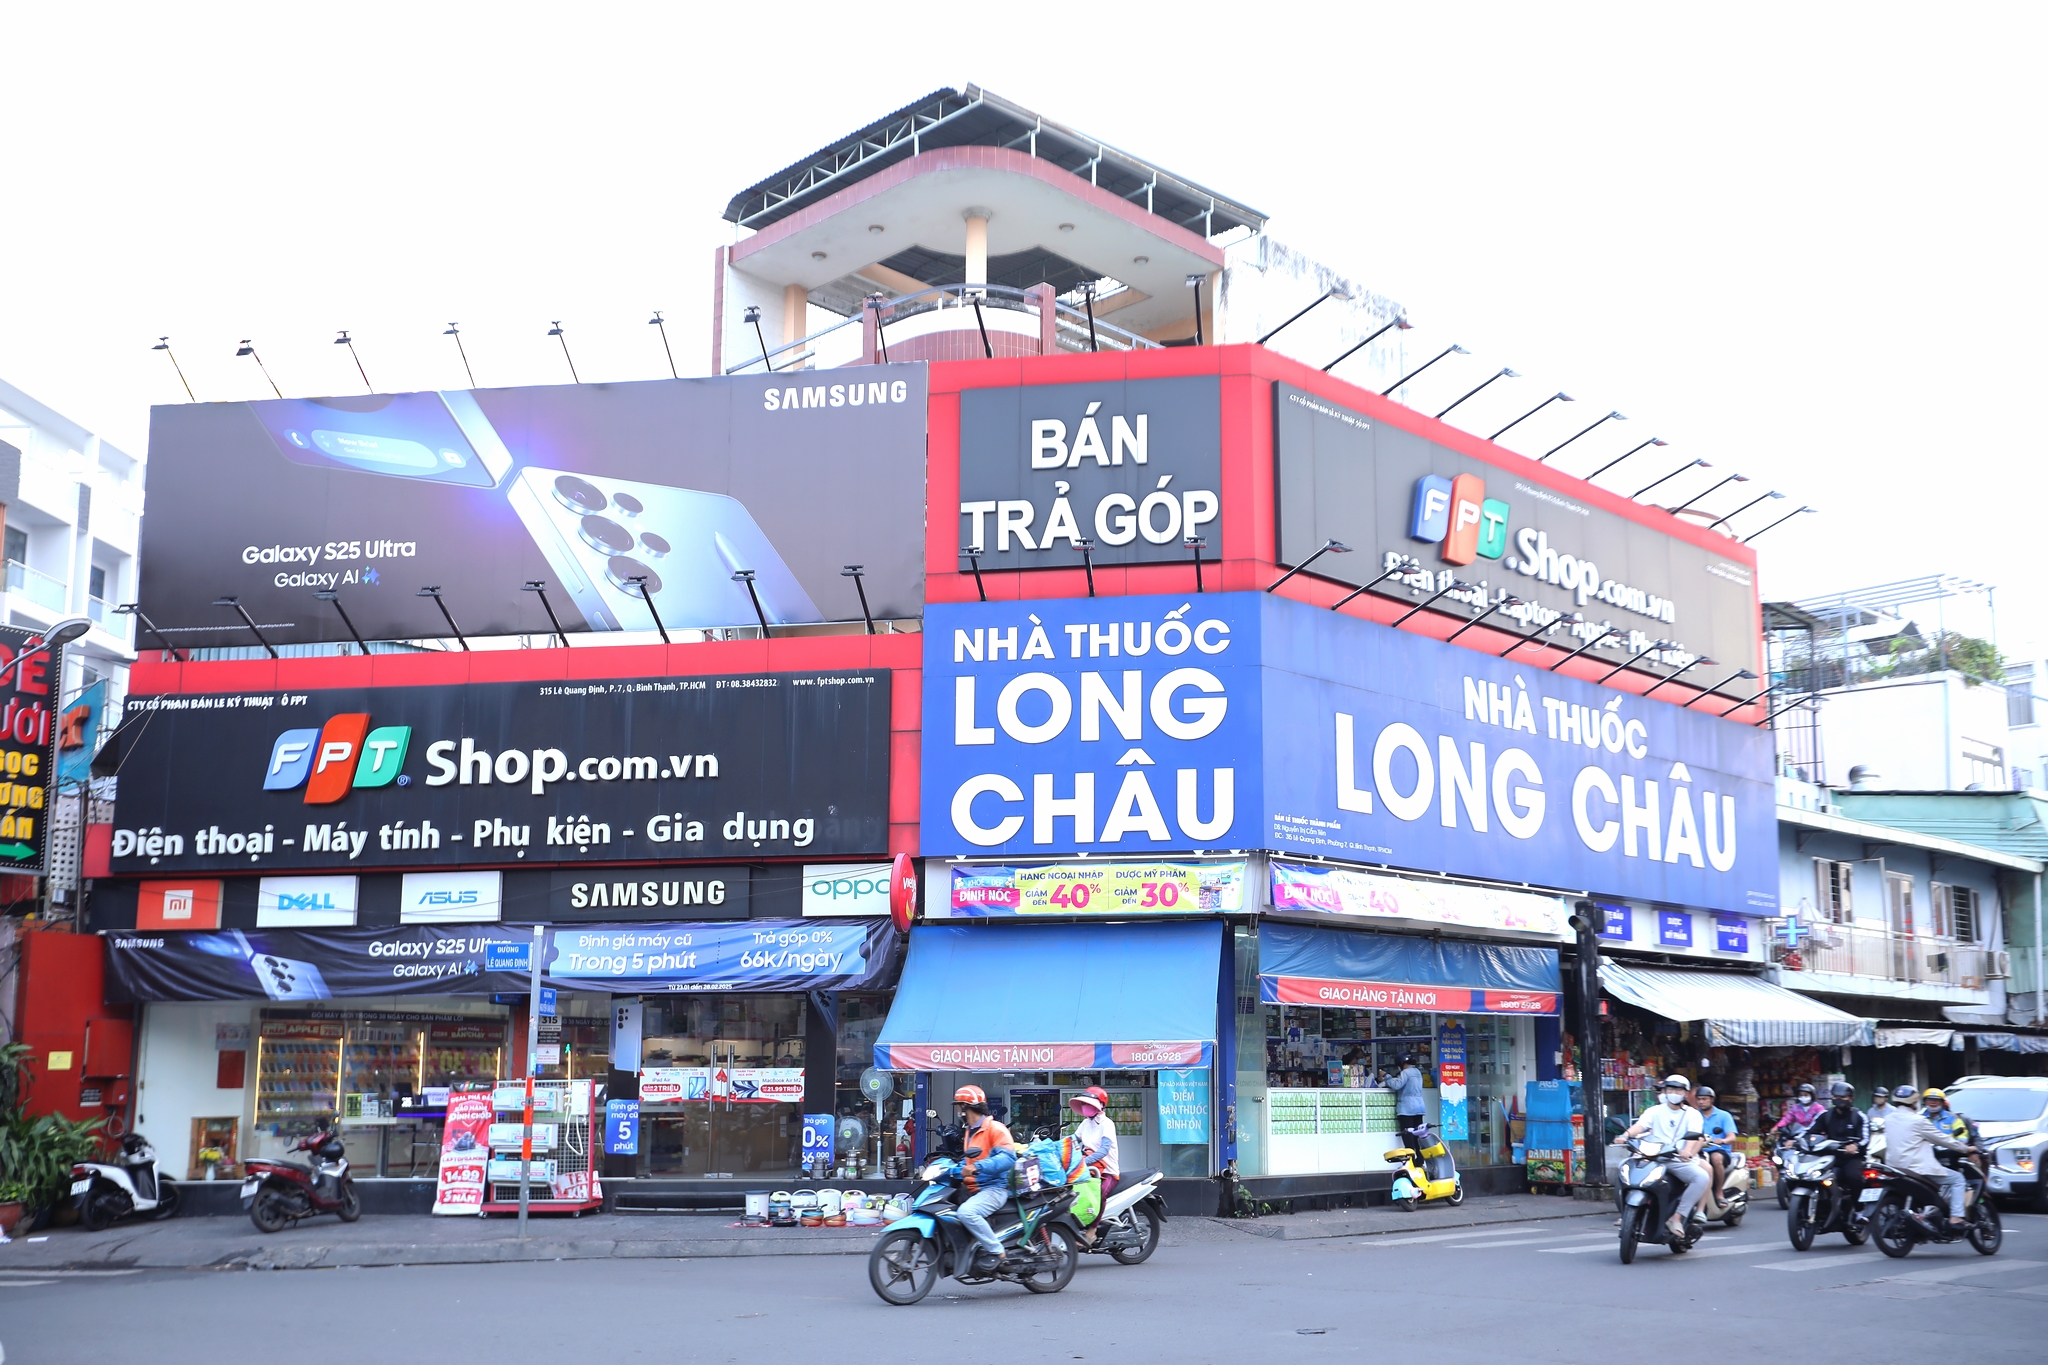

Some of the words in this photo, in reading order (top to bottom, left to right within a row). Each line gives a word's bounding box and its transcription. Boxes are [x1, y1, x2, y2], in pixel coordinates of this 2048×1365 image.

[764, 380, 907, 411] SAMSUNG
[1031, 401, 1148, 469] BÁN
[960, 481, 1081, 552] TRẢ
[1094, 475, 1219, 545] GÓP
[242, 545, 321, 566] Galaxy
[324, 542, 361, 562] S25
[364, 540, 416, 559] Ultra
[274, 571, 339, 589] Galaxy
[342, 569, 359, 585] AI
[954, 613, 1056, 663] NHÀ
[1064, 602, 1231, 658] THUỐC
[540, 687, 552, 695] 315
[553, 686, 563, 695] Lê
[564, 686, 587, 696] Quang
[588, 684, 608, 695] Định,
[636, 683, 652, 691] Bình
[127, 700, 147, 711] CTY
[290, 695, 308, 706] FPT
[955, 667, 1228, 745] LONG
[1464, 674, 1537, 735] NHÀ
[1542, 694, 1648, 760] THUỐC
[425, 737, 718, 794] Shop.com.vn
[951, 748, 1235, 846] CHÂU
[1335, 712, 1547, 839] LONG
[1572, 762, 1737, 872] CHÂU
[111, 828, 184, 865] Điện
[195, 824, 273, 862] thoại
[304, 822, 367, 859] Máy
[379, 821, 440, 850] tính
[474, 818, 530, 858] Phụ
[547, 815, 611, 853] kiện
[646, 813, 704, 842] Gia
[722, 812, 815, 848] dụng
[1020, 871, 1046, 881] HÀNG
[1048, 871, 1078, 881] NGOẠI
[1079, 870, 1104, 879] NHẬP
[1115, 870, 1141, 880] DƯỢC
[1143, 868, 1157, 878] MỸ
[1159, 869, 1186, 879] PHẨM
[278, 893, 335, 911] DELL
[418, 890, 478, 905] ASUS
[570, 880, 726, 908] SAMSUNG
[1050, 883, 1101, 908] 40%
[1114, 887, 1138, 897] GIẢM
[1141, 881, 1190, 907] 30%
[114, 938, 164, 950] SAMSUNG
[579, 934, 611, 951] Định
[612, 934, 635, 950] giá
[638, 935, 670, 949] máy
[673, 935, 692, 946] cũ
[753, 931, 776, 944] Trả
[779, 931, 809, 947] góp
[812, 931, 833, 943] 0%
[368, 941, 432, 960] Galaxy
[435, 939, 465, 955] S25
[497, 945, 519, 954] ĐƯỜNG
[393, 964, 445, 978] Galaxy
[447, 962, 462, 976] AI
[495, 959, 513, 967] QUANG
[514, 958, 528, 969] ĐỊNH
[569, 954, 627, 974] Trong
[632, 954, 644, 969] 5
[647, 952, 696, 974] phút
[740, 949, 843, 973] 66k/ngày
[1319, 987, 1351, 1001] GIAO
[1353, 987, 1388, 1003] HÀNG
[1390, 990, 1413, 1007] TẬN
[1416, 992, 1436, 1006] NƠI
[288, 1025, 319, 1034] APPLE
[930, 1047, 961, 1064] GIAO
[963, 1045, 1001, 1064] HÀNG
[1003, 1045, 1029, 1067] TẬN
[1032, 1048, 1054, 1063] NƠI
[1131, 1052, 1154, 1062] 1800
[1157, 1051, 1181, 1061] 6928
[1173, 1089, 1195, 1102] ĐIỂM
[611, 1103, 626, 1111] Định
[627, 1103, 638, 1111] giá
[611, 1111, 628, 1120] máy
[1160, 1103, 1177, 1115] BÁN
[1179, 1102, 1208, 1115] THUỐC
[618, 1121, 631, 1140] 5
[814, 1118, 828, 1126] góp
[1166, 1118, 1186, 1130] BÌNH
[614, 1142, 634, 1152] phút
